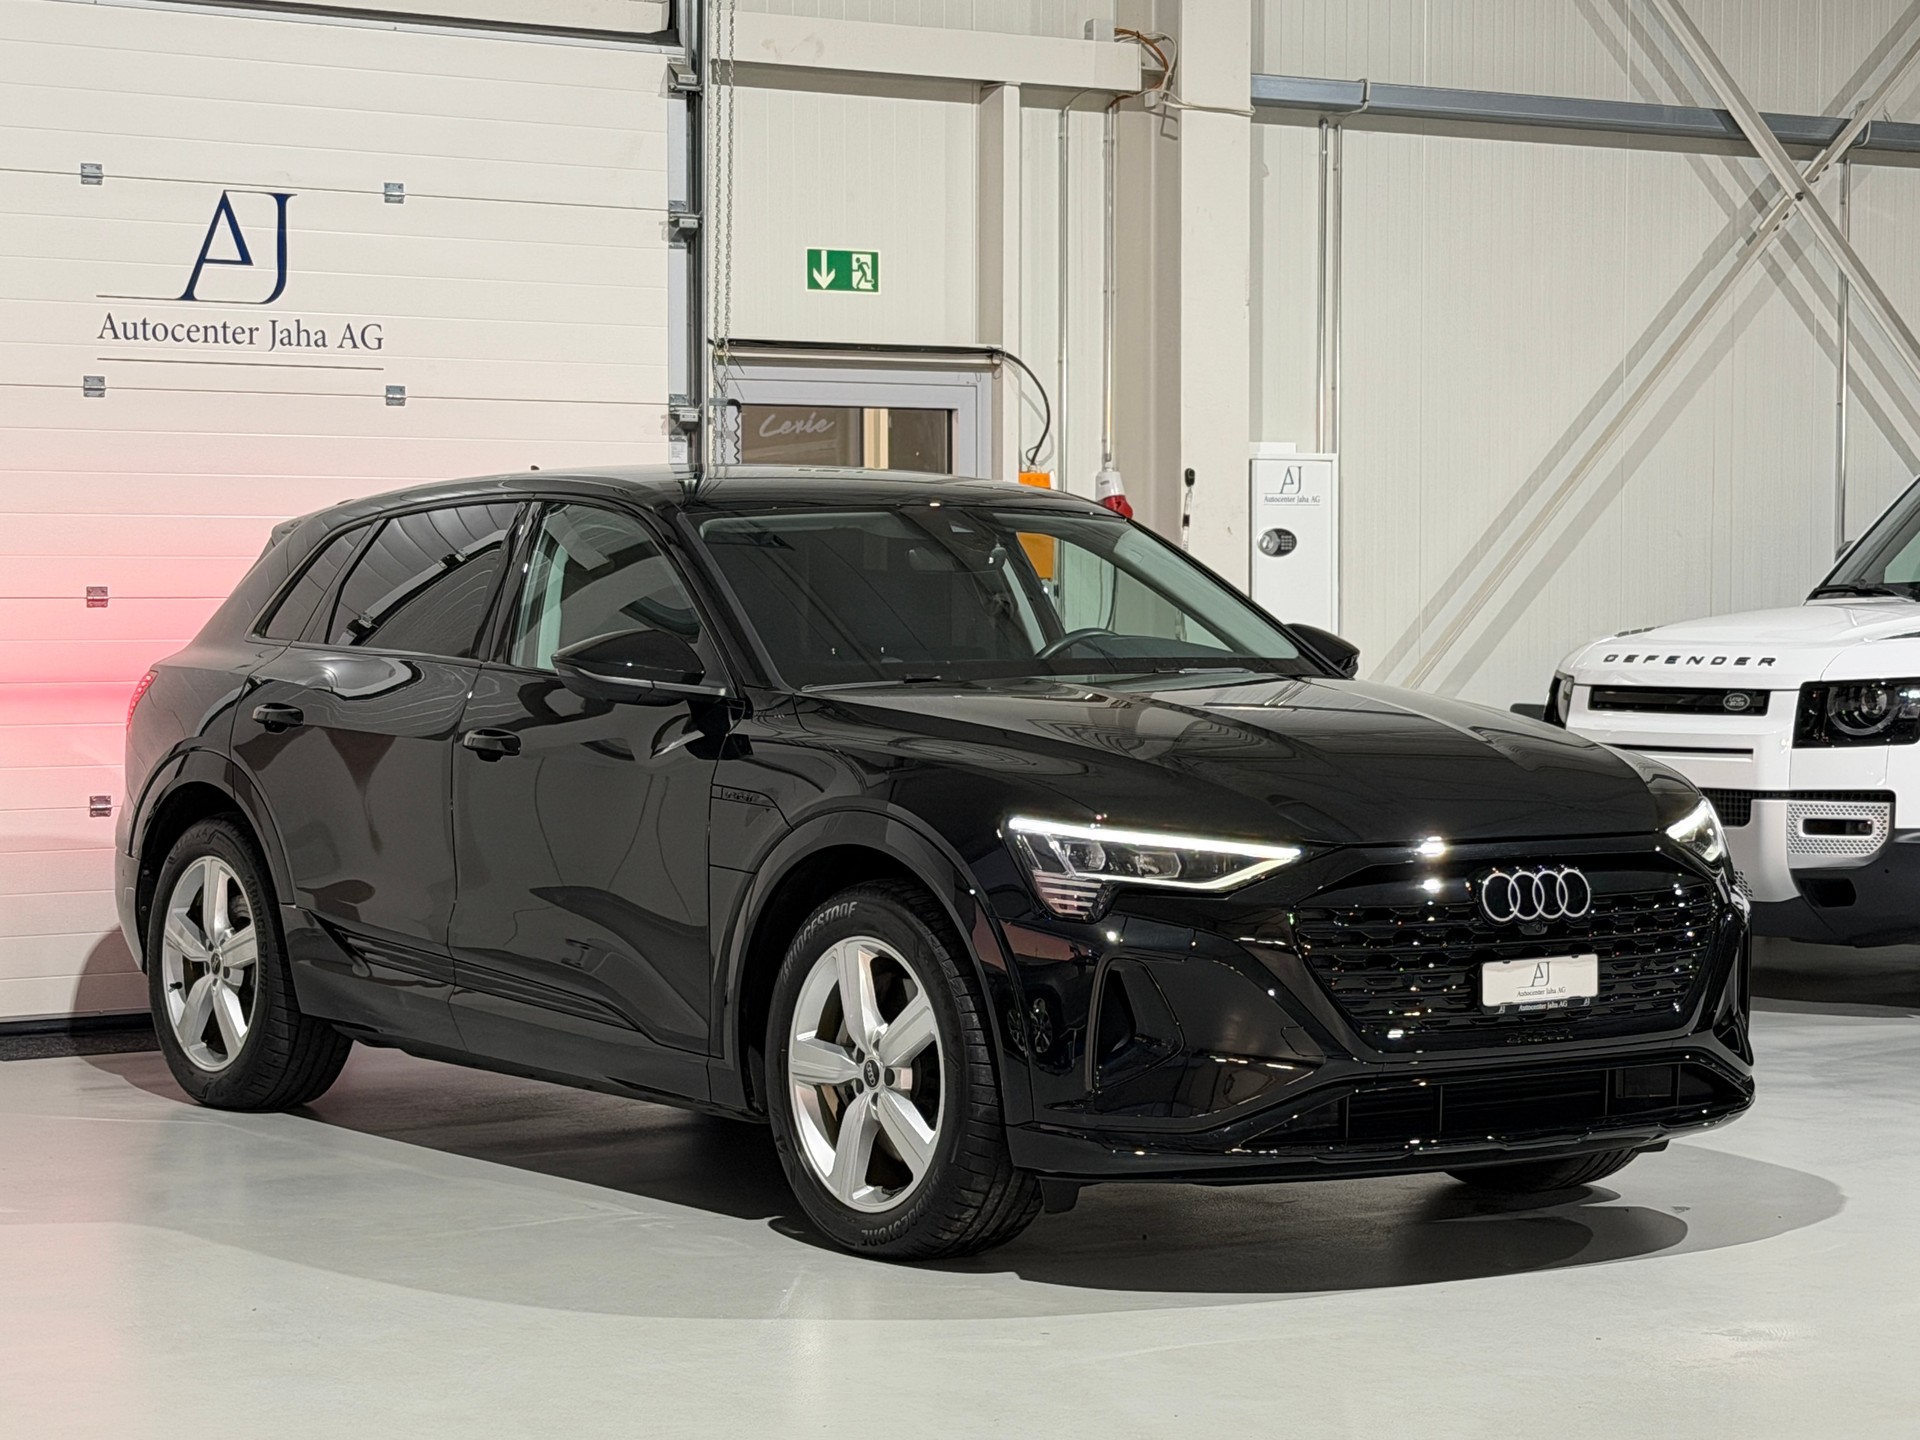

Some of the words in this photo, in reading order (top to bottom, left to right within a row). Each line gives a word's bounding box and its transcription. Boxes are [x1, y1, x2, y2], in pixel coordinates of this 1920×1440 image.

[176, 189, 298, 305] AJ
[96, 312, 260, 346] Autocenter
[268, 319, 329, 352] Jaha
[337, 323, 385, 351] AG
[1279, 465, 1304, 495] AJ
[1264, 495, 1296, 503] Autocenter
[1297, 495, 1309, 504] Jaha
[1311, 495, 1321, 503] AG
[1602, 653, 1777, 667] DEFENDER
[1528, 961, 1551, 988] AJ
[1516, 988, 1545, 998] Autocenter
[1546, 987, 1557, 996] Jaha
[1558, 986, 1566, 994] AG
[1518, 1001, 1547, 1012] Autocenter
[1547, 1000, 1559, 1010] Jaha
[1559, 999, 1568, 1008] AG
